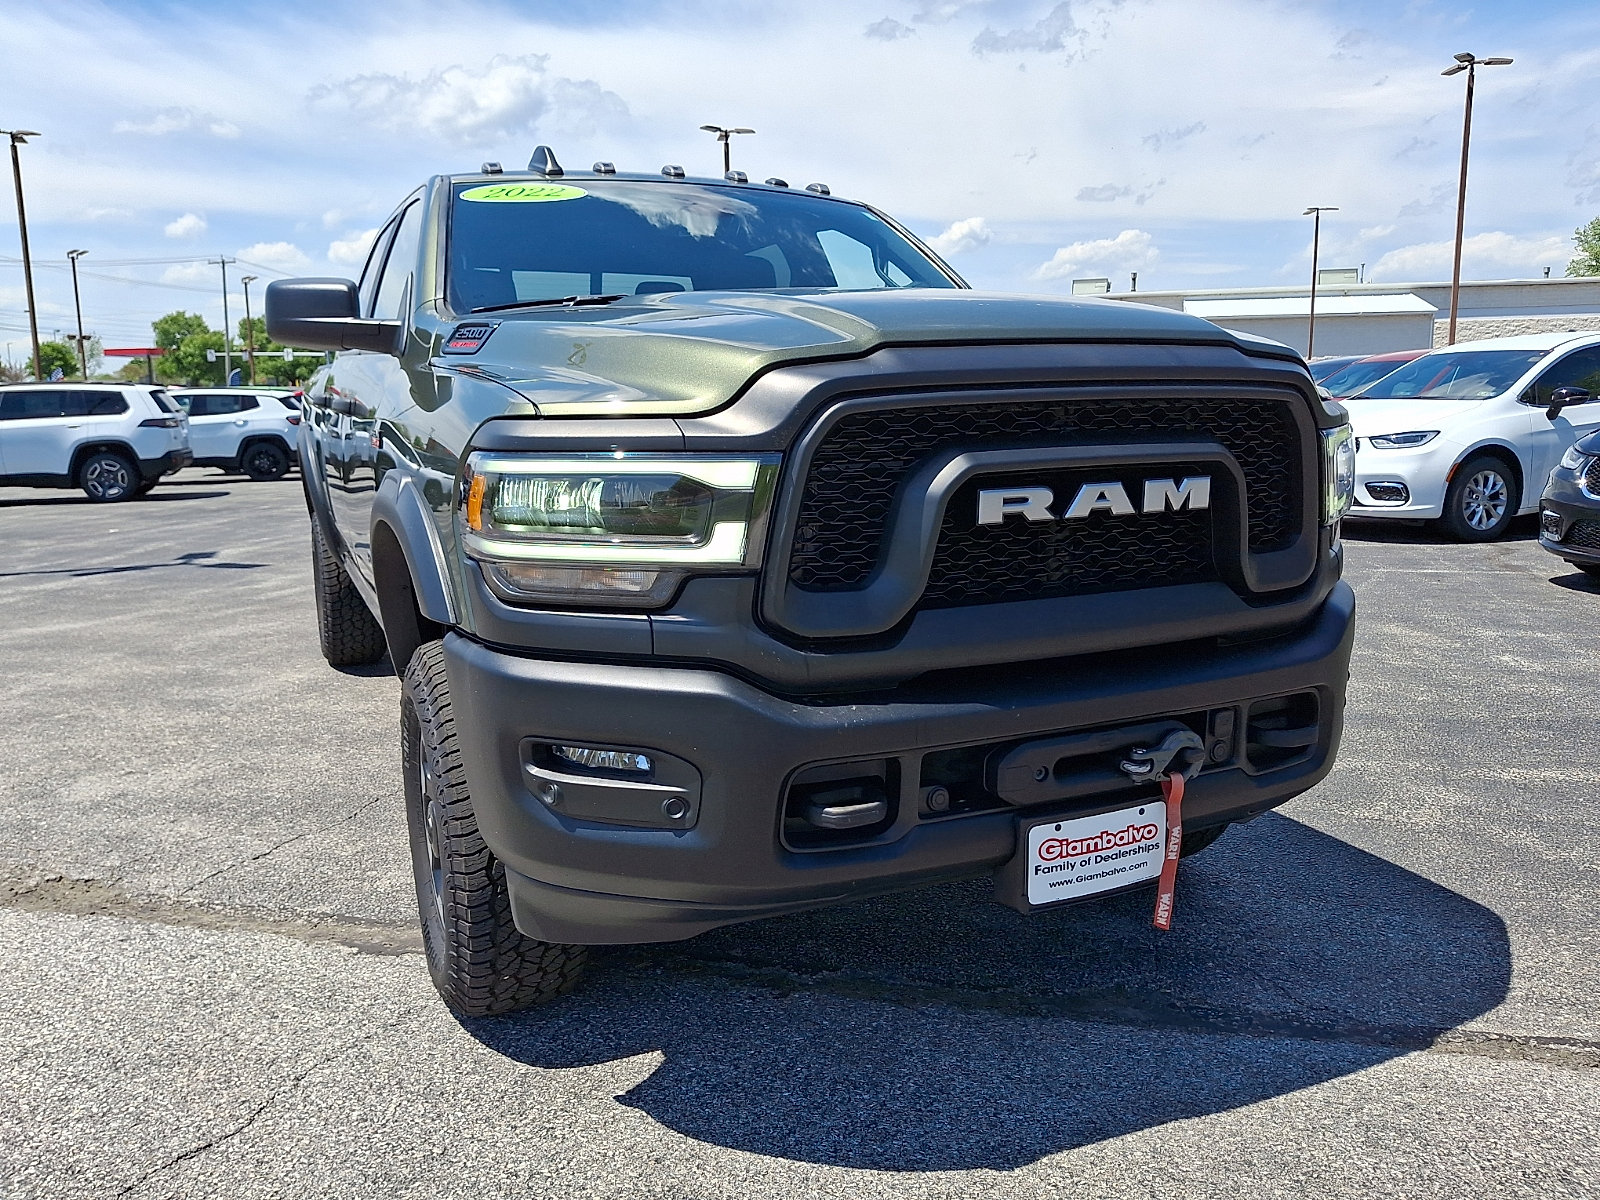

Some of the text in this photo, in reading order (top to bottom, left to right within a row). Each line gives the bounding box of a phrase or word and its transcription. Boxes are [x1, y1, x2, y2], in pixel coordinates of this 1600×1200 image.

[483, 187, 566, 199] 2022
[455, 328, 486, 339] 2500
[977, 474, 1212, 525] RAM
[1038, 824, 1159, 861] Giambalvo
[1034, 842, 1160, 876] Family of Dealerships
[1048, 861, 1148, 889] www.Giambalvo.com
